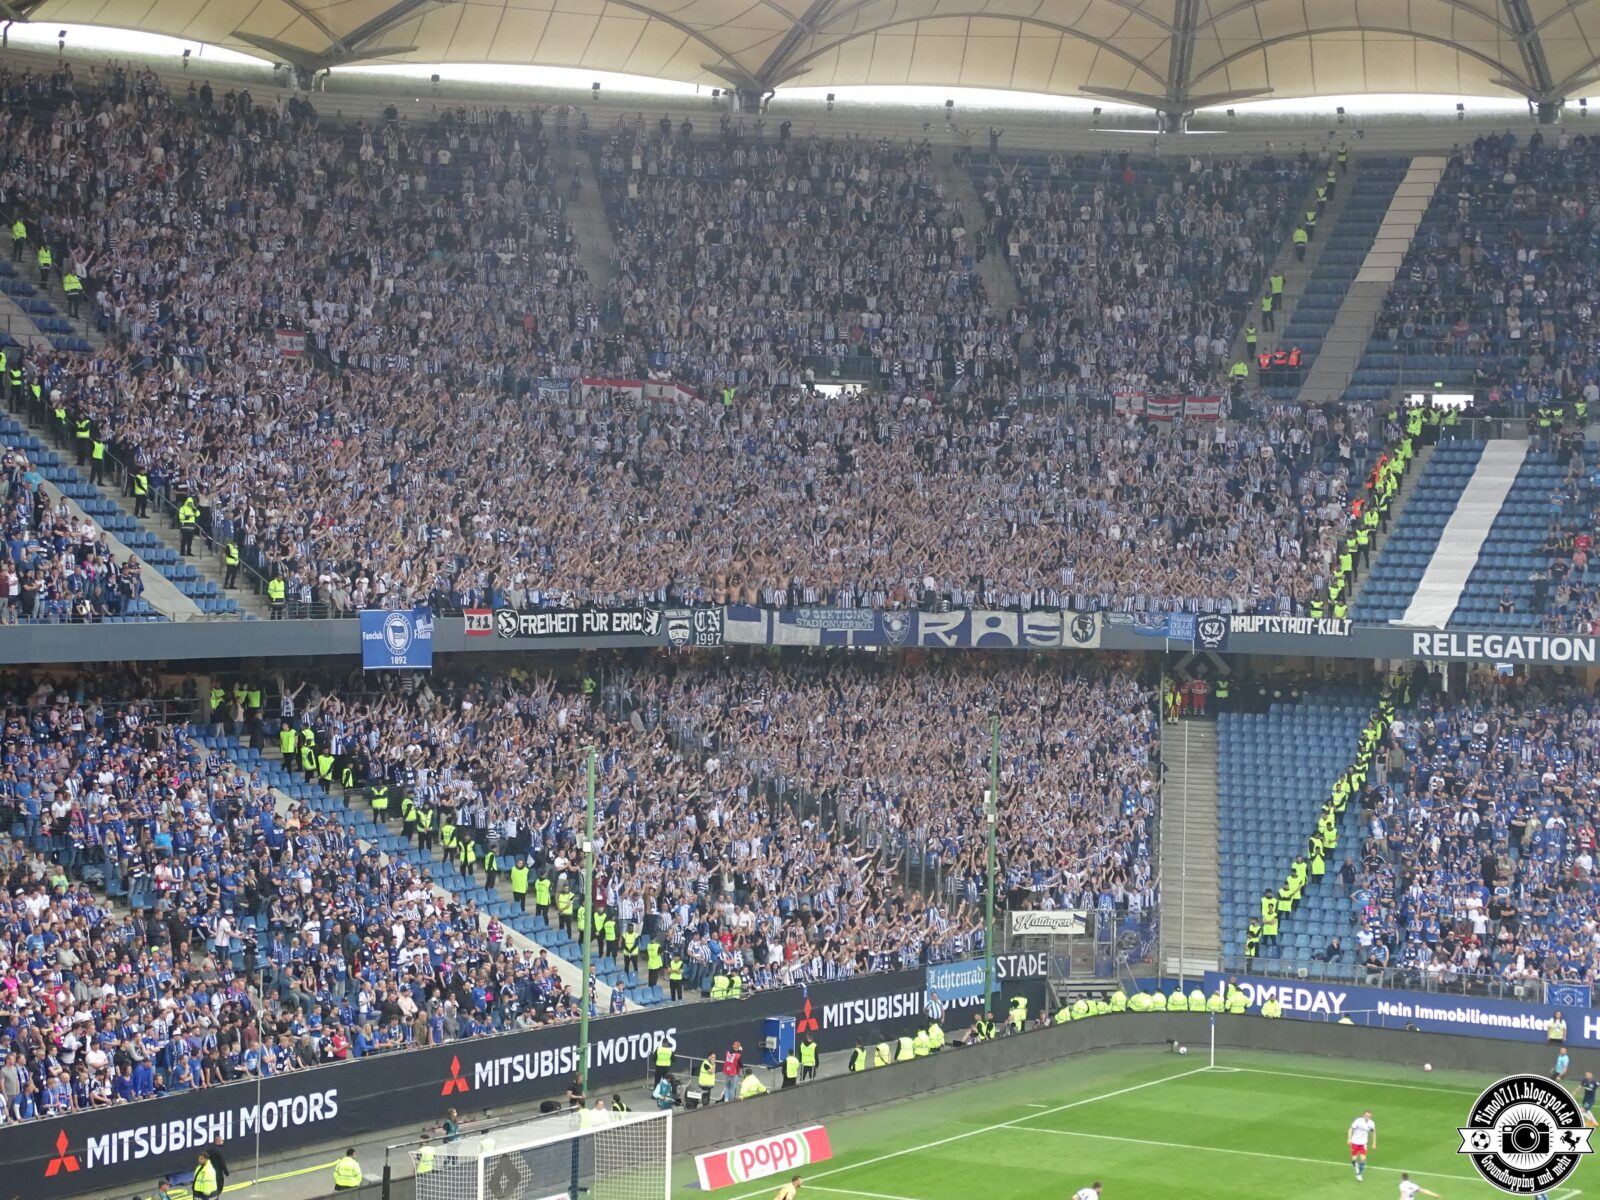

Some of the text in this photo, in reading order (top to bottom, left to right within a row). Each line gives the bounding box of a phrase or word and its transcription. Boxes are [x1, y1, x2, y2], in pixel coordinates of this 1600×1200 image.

[520, 613, 579, 635] FREIHEIT
[582, 609, 609, 633] FÜR
[612, 612, 642, 632] ERIC
[796, 617, 873, 629] STADIONVERBOT
[813, 609, 861, 620] SEKTION
[1230, 615, 1353, 636] HAUPTSTADT-KULT
[362, 631, 383, 641] Fanclub
[695, 632, 722, 646] 1997
[1204, 622, 1220, 635] SZ
[1413, 632, 1596, 662] RELEGATION
[391, 656, 407, 665] 1892
[1014, 913, 1072, 931] Hattingen
[996, 952, 1048, 978] STADE
[823, 991, 920, 1029] MITSUBISHI
[1377, 1001, 1551, 1031] Mein Immobilienmakler
[597, 1027, 677, 1066] MOTORS
[87, 1089, 338, 1169] MITSUBISHI MOTORS
[740, 1137, 798, 1179] popp
